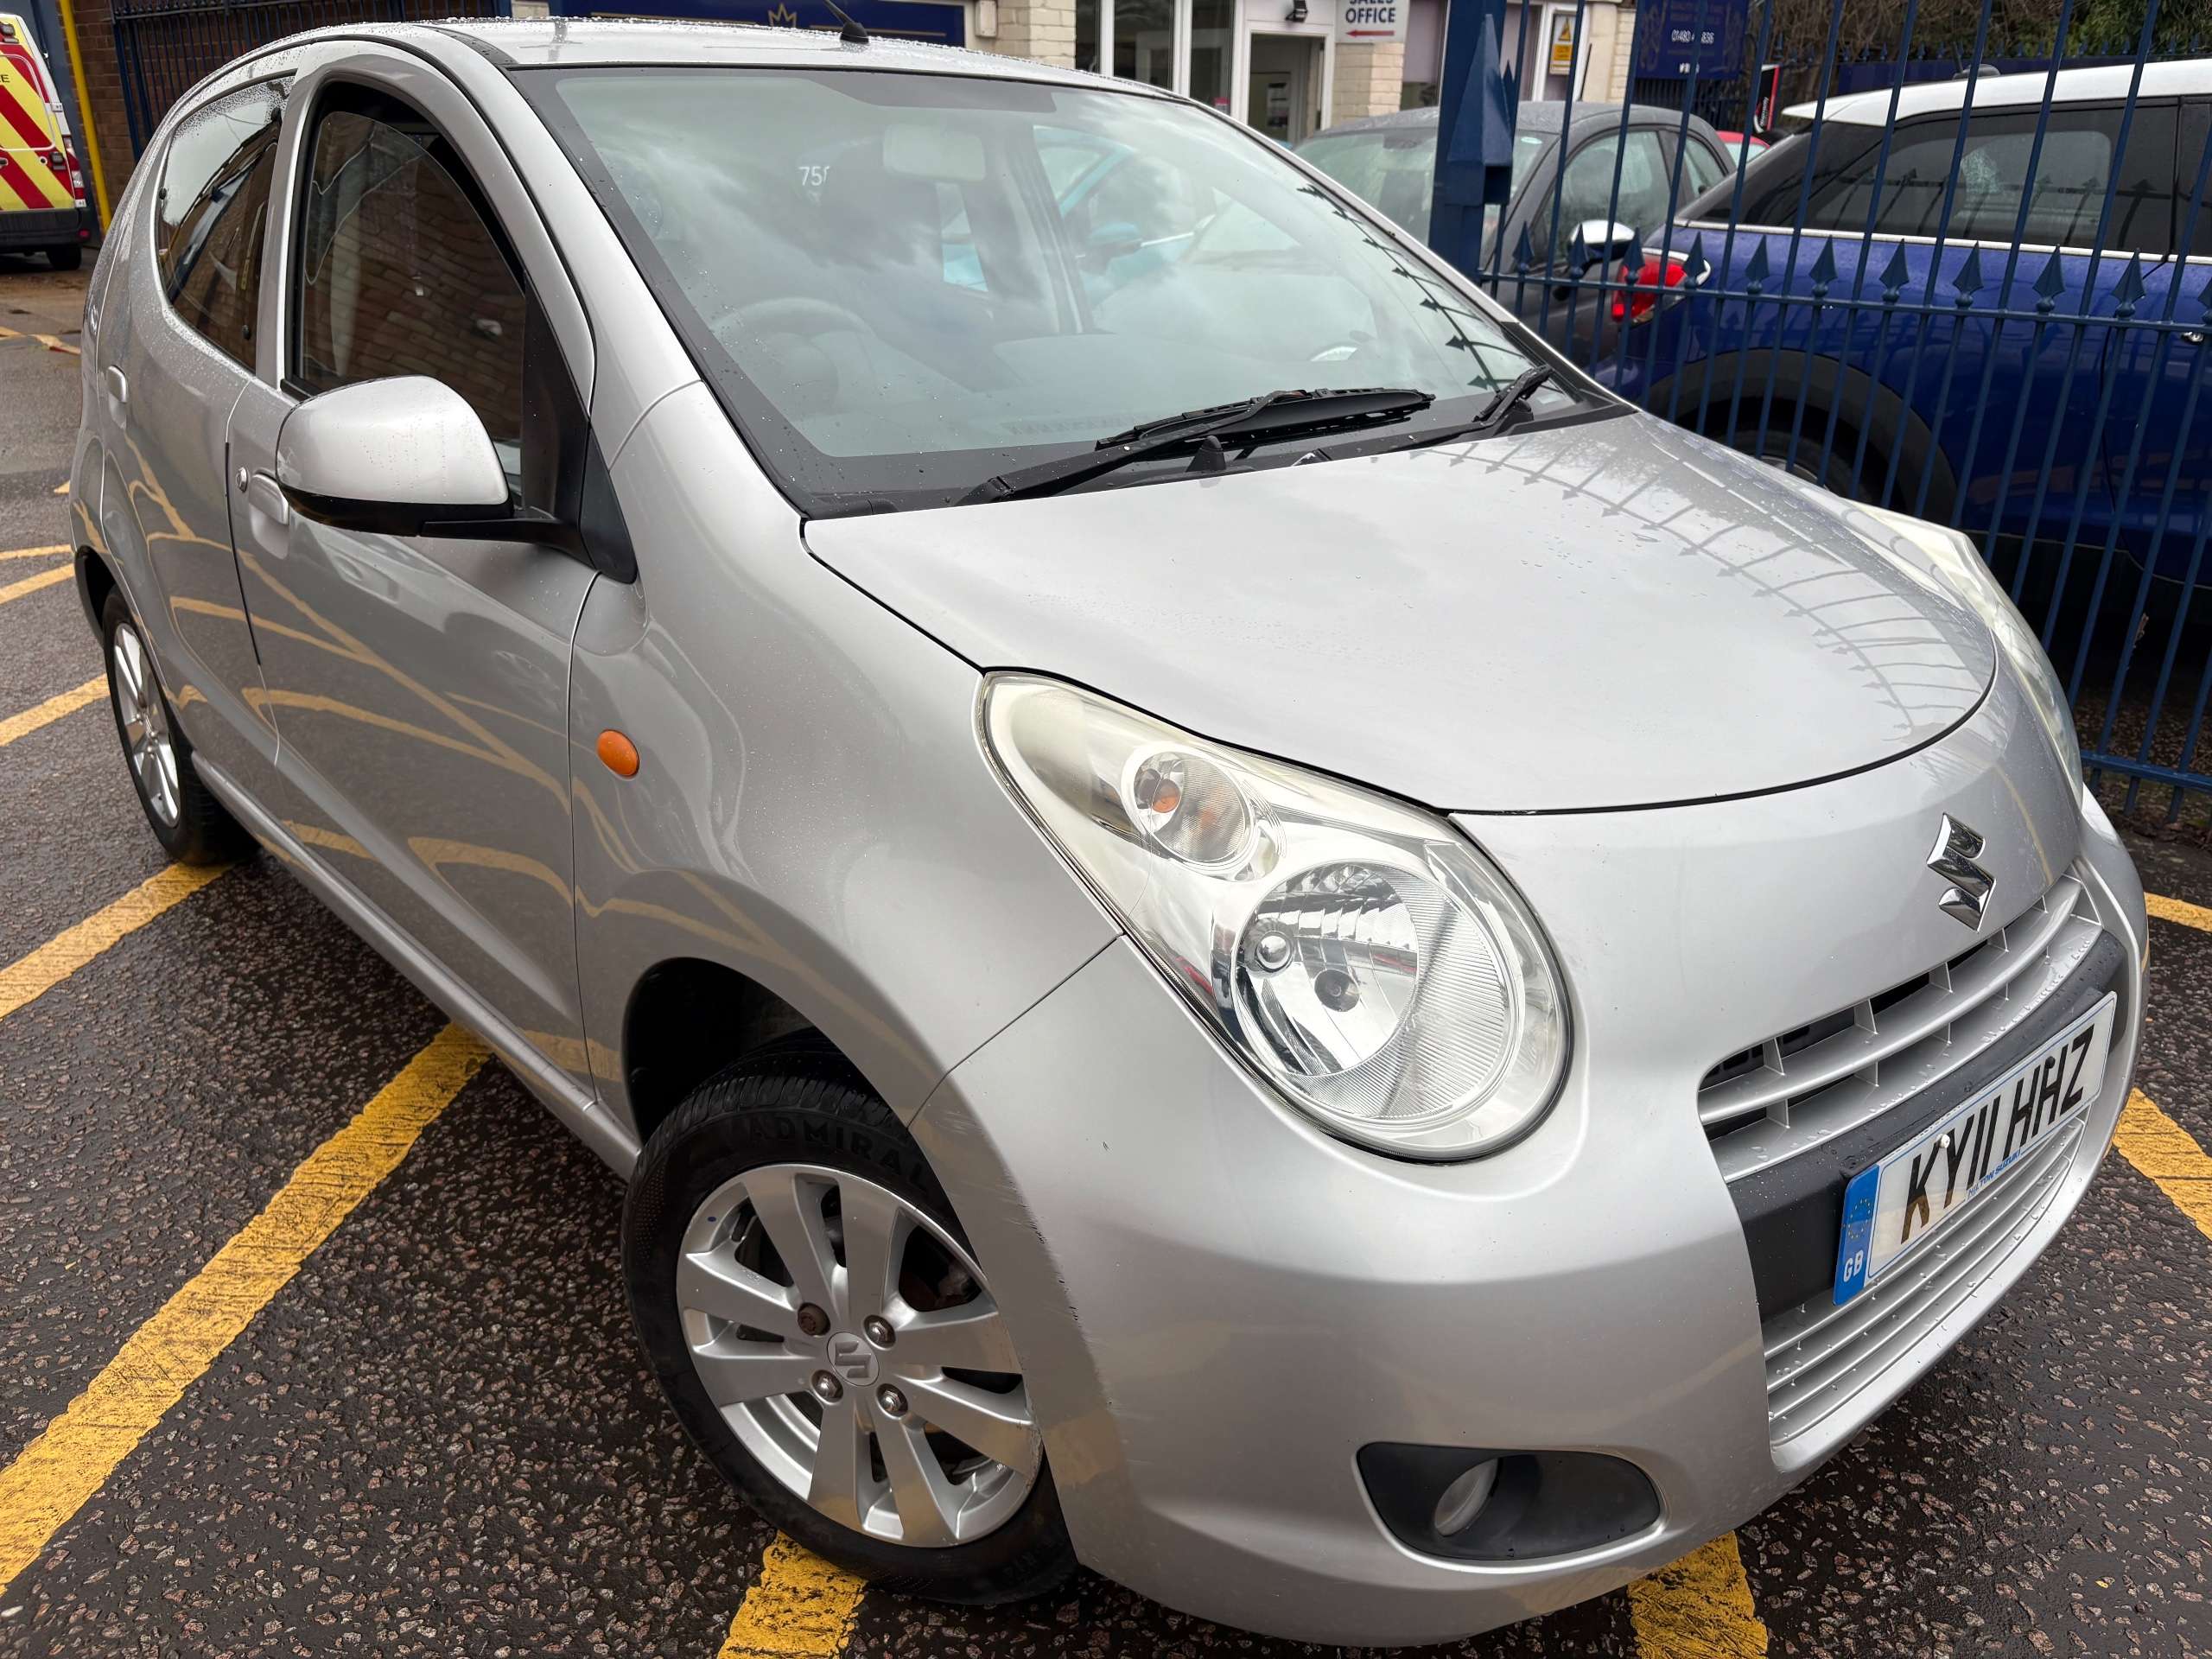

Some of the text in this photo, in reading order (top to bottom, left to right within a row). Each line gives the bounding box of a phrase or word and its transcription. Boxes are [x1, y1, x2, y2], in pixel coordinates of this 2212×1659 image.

[1345, 8, 1396, 23] OFFICE
[1901, 1023, 2094, 1244] KY11 HHZ
[748, 1116, 928, 1192] ADMIRAL
[1995, 1147, 2021, 1175] SUZUKI
[1843, 1249, 1864, 1283] GB
